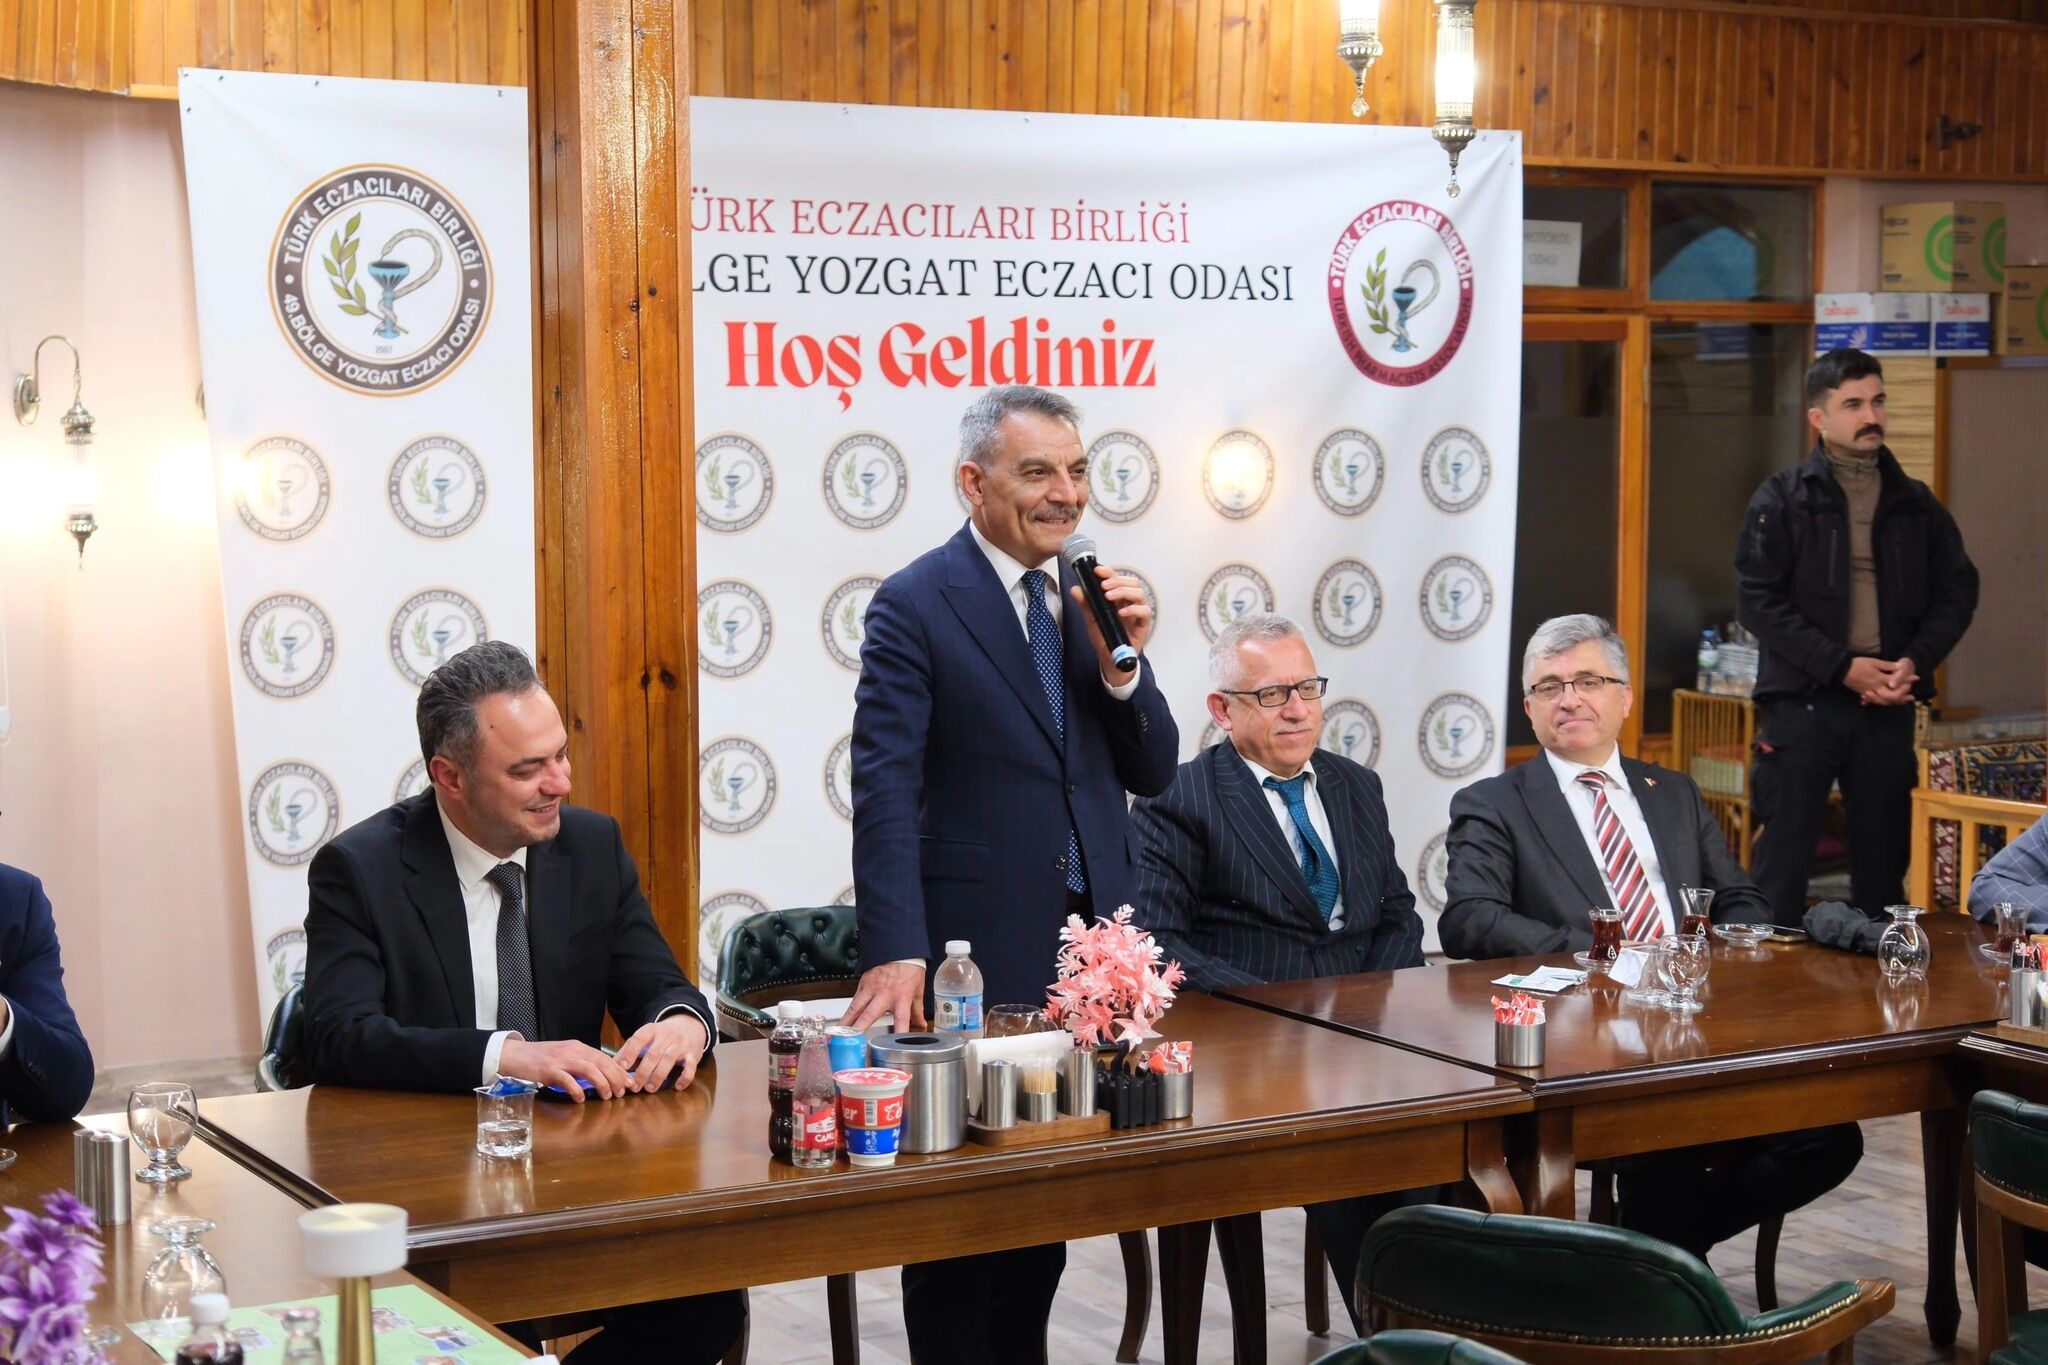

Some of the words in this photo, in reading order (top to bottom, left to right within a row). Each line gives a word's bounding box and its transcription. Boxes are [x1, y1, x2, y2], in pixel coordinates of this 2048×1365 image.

[284, 211, 318, 264] TÜRK
[312, 177, 431, 216] ECZACILARI
[791, 200, 1036, 240] ECZACILARI
[1050, 199, 1191, 244] BİRLİĞİ
[786, 255, 978, 297] YOZGAT
[993, 259, 1153, 300] ECZACI
[1169, 263, 1294, 301] ODASI
[337, 359, 399, 385] YOZGAT
[401, 345, 454, 383] ECZACI
[449, 298, 481, 350] ODASI
[724, 320, 862, 413] Hoş
[878, 315, 1157, 388] Geldiniz
